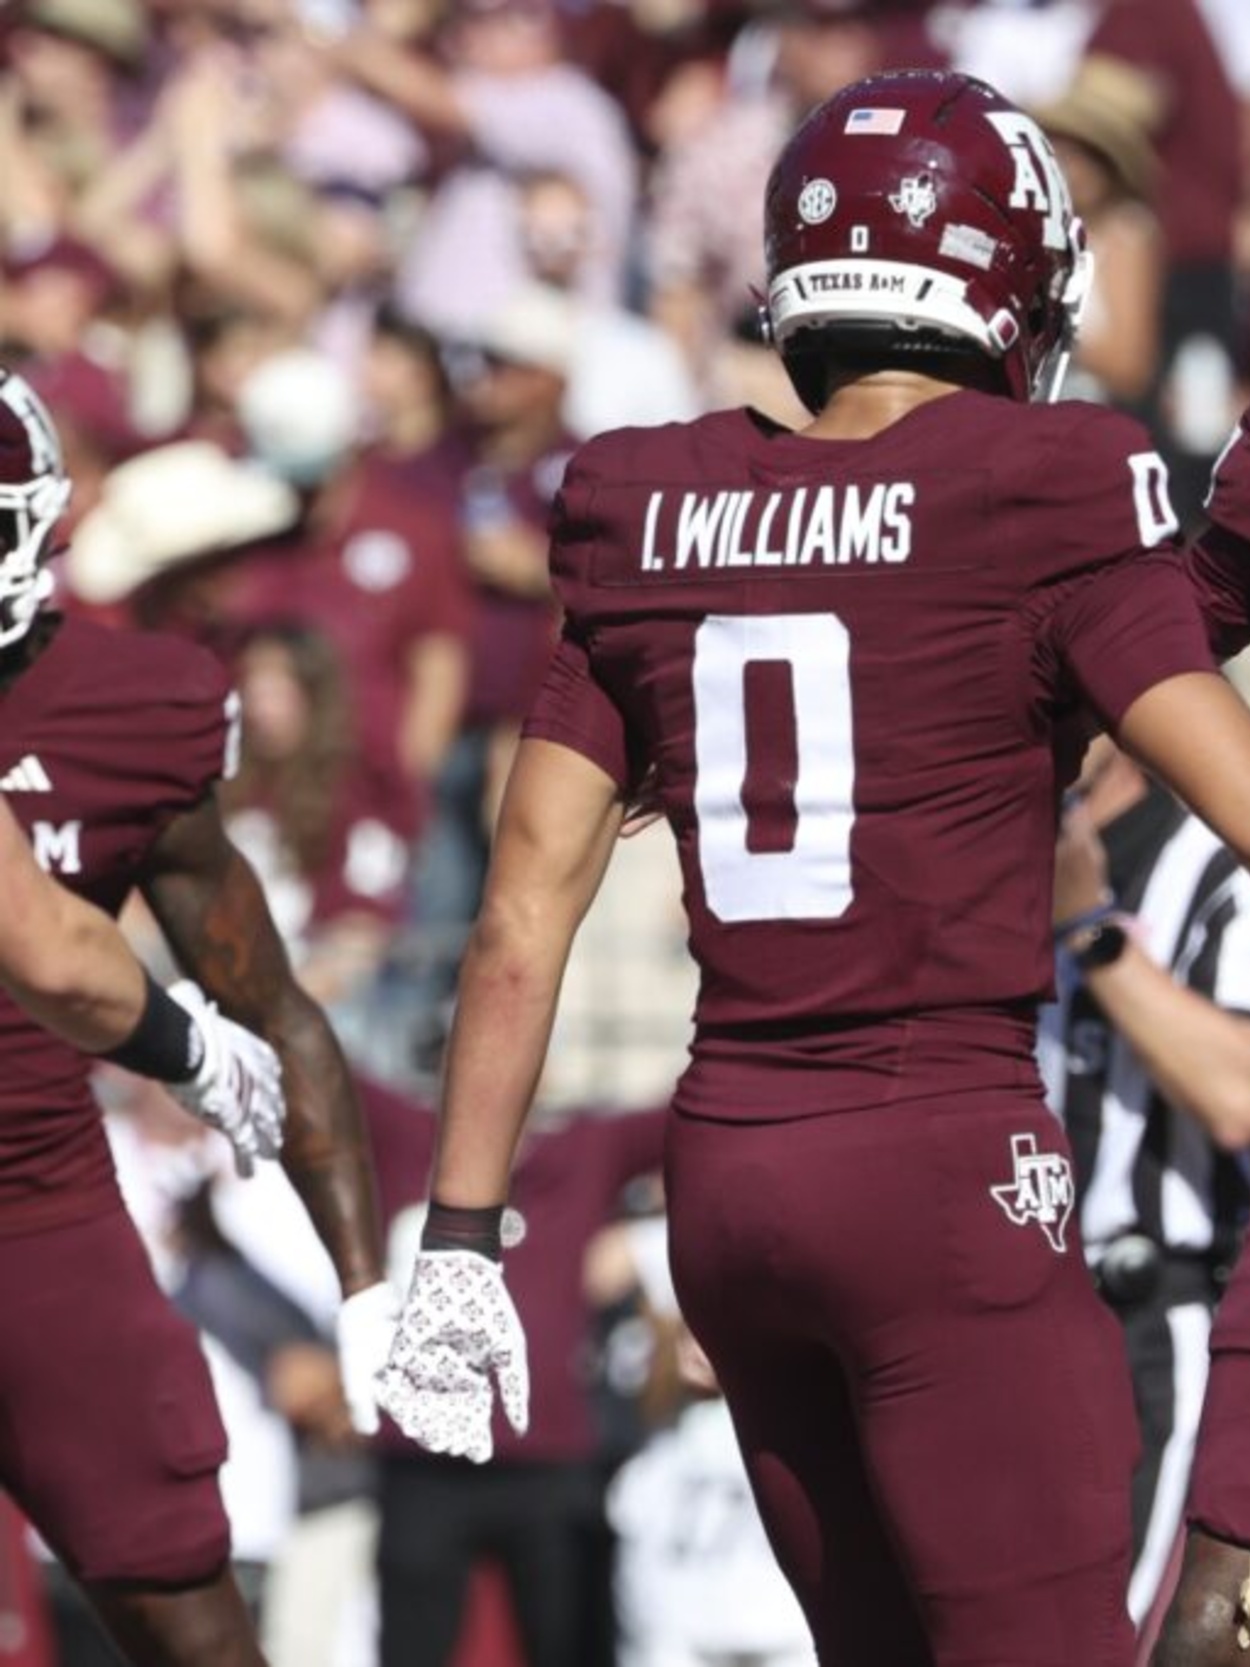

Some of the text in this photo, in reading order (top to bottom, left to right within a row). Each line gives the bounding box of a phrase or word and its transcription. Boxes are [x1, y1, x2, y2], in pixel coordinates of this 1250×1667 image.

[808, 272, 863, 293] TEXAS
[850, 226, 869, 253] 0
[641, 482, 915, 571] I. WILLIAMS
[1127, 452, 1180, 547] 0
[692, 613, 856, 922] 0
